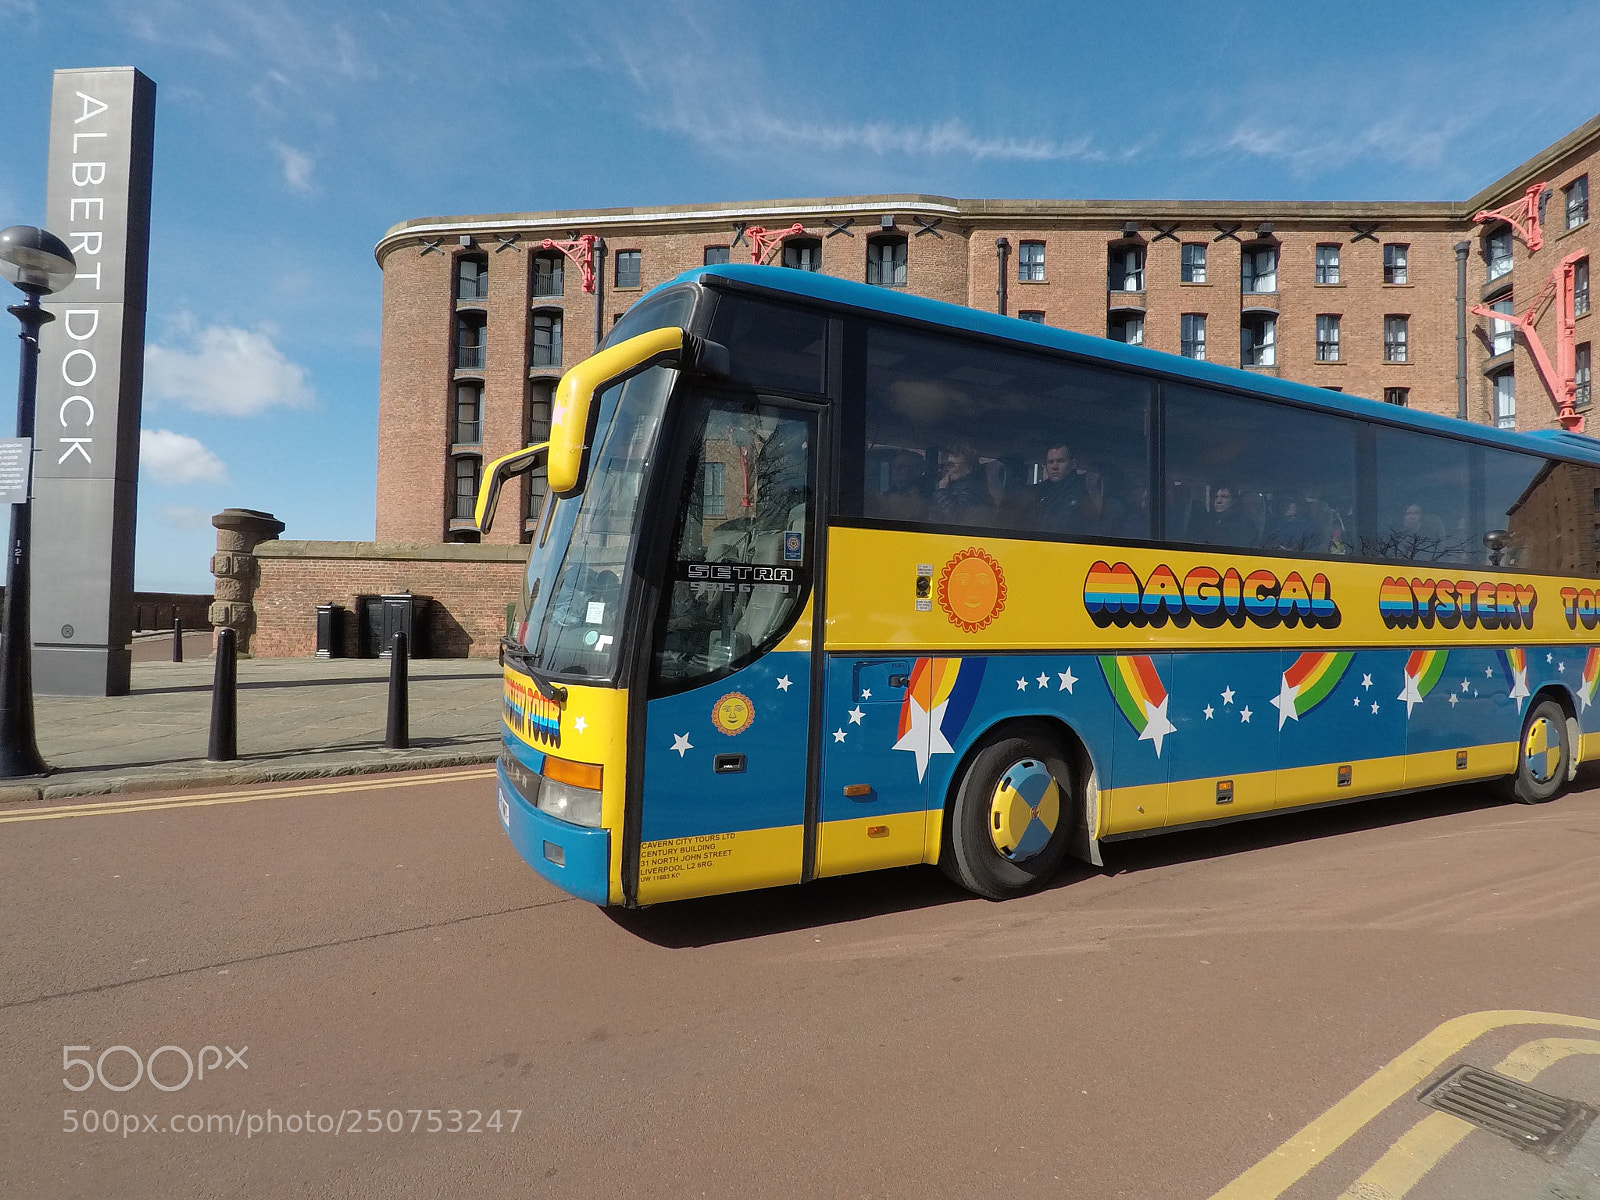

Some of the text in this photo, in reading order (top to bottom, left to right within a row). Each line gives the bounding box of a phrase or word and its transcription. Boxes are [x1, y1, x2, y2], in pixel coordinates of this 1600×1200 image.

[58, 90, 109, 465] ALBERT DOCK
[688, 564, 794, 582] SETRA
[1083, 561, 1342, 630] MAGICAL
[1379, 576, 1537, 631] MYSTERY
[527, 687, 561, 750] TOUR
[641, 832, 736, 850] CAVERN CITY TOURS LTD
[641, 843, 716, 858] CENTURY BUILDING
[651, 856, 679, 866] NORTH
[681, 853, 702, 862] JOHN
[703, 849, 732, 859] STREET
[640, 865, 685, 875] LIVERPOOL
[686, 862, 696, 870] L2
